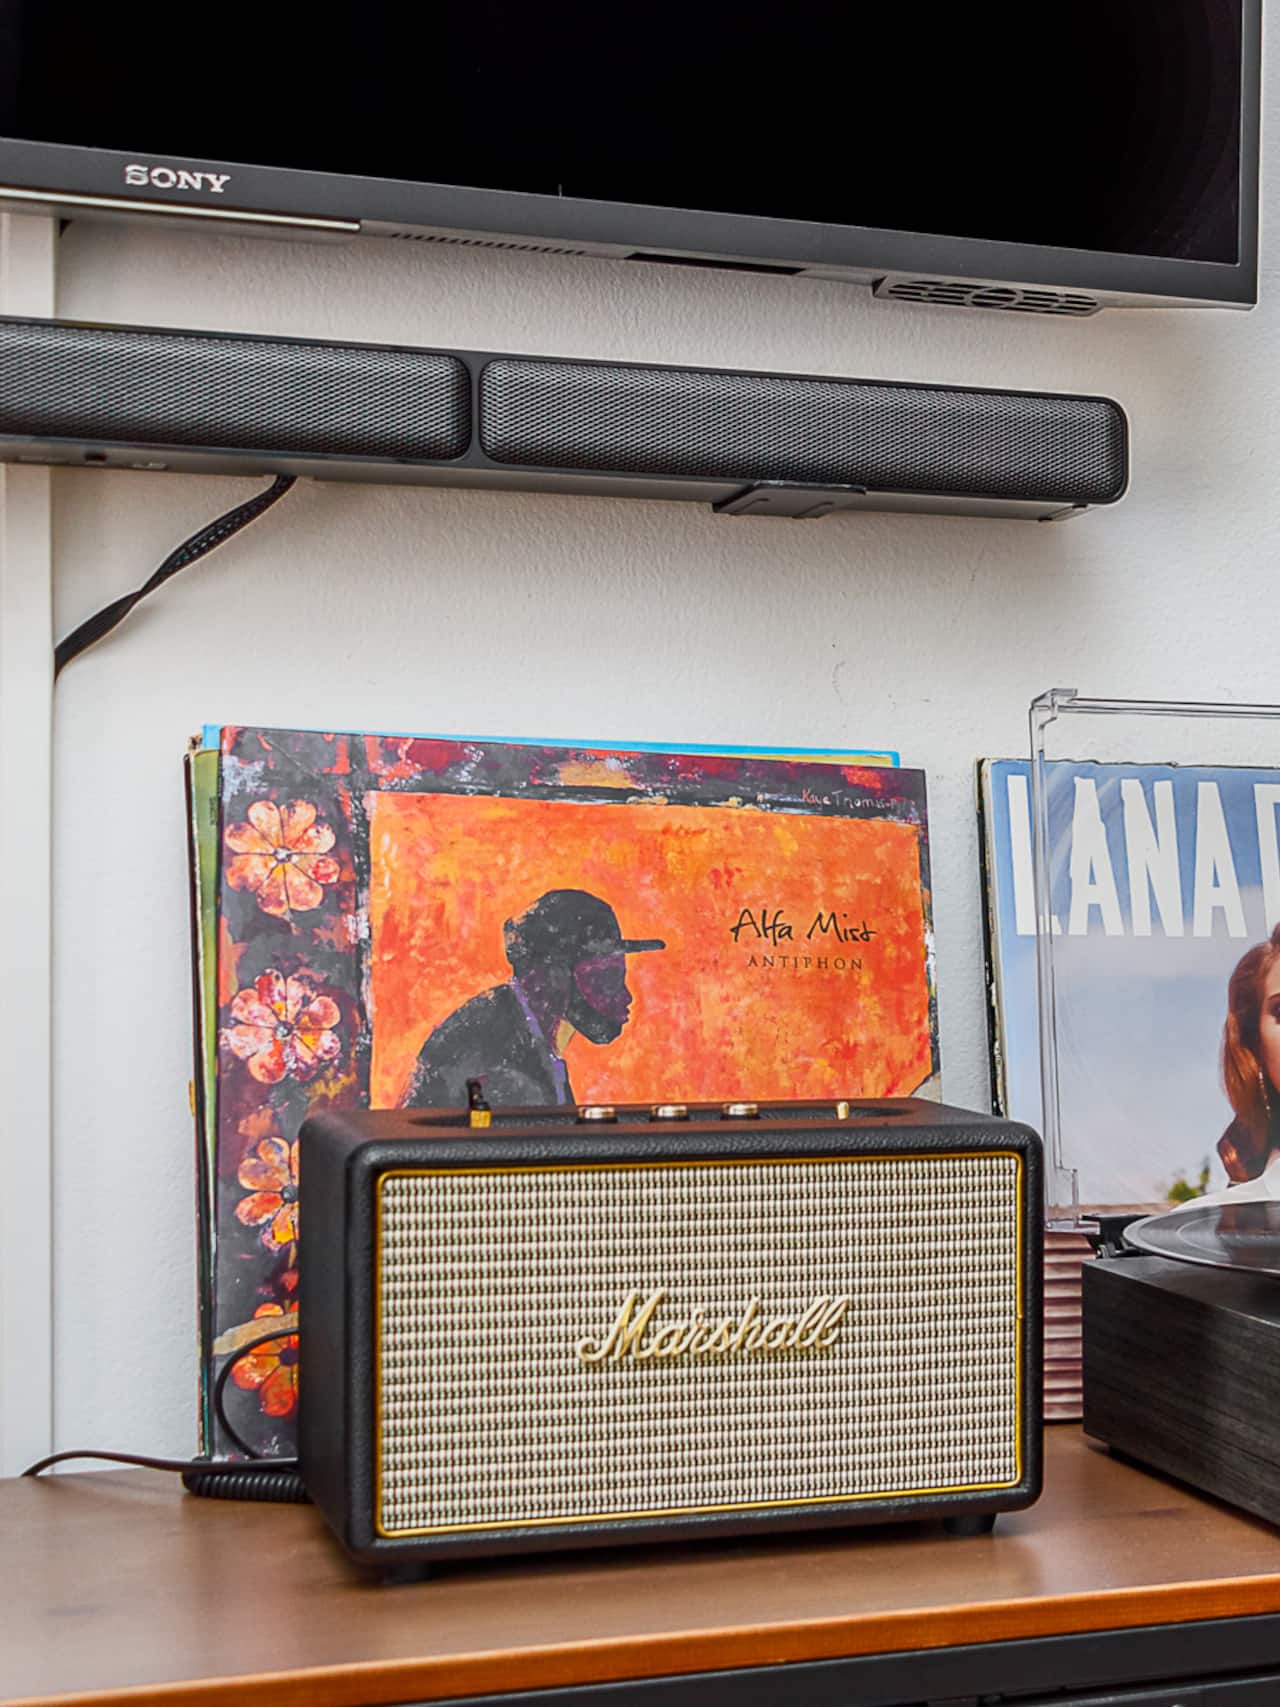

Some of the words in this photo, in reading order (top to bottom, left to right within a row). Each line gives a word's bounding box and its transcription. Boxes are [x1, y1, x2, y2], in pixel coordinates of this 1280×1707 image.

[125, 164, 231, 193] SONY
[1006, 774, 1250, 939] LANA
[730, 908, 794, 946] Alfa
[806, 912, 877, 942] Mist
[748, 955, 863, 970] ANTIPHON
[578, 1287, 849, 1361] Marshall
